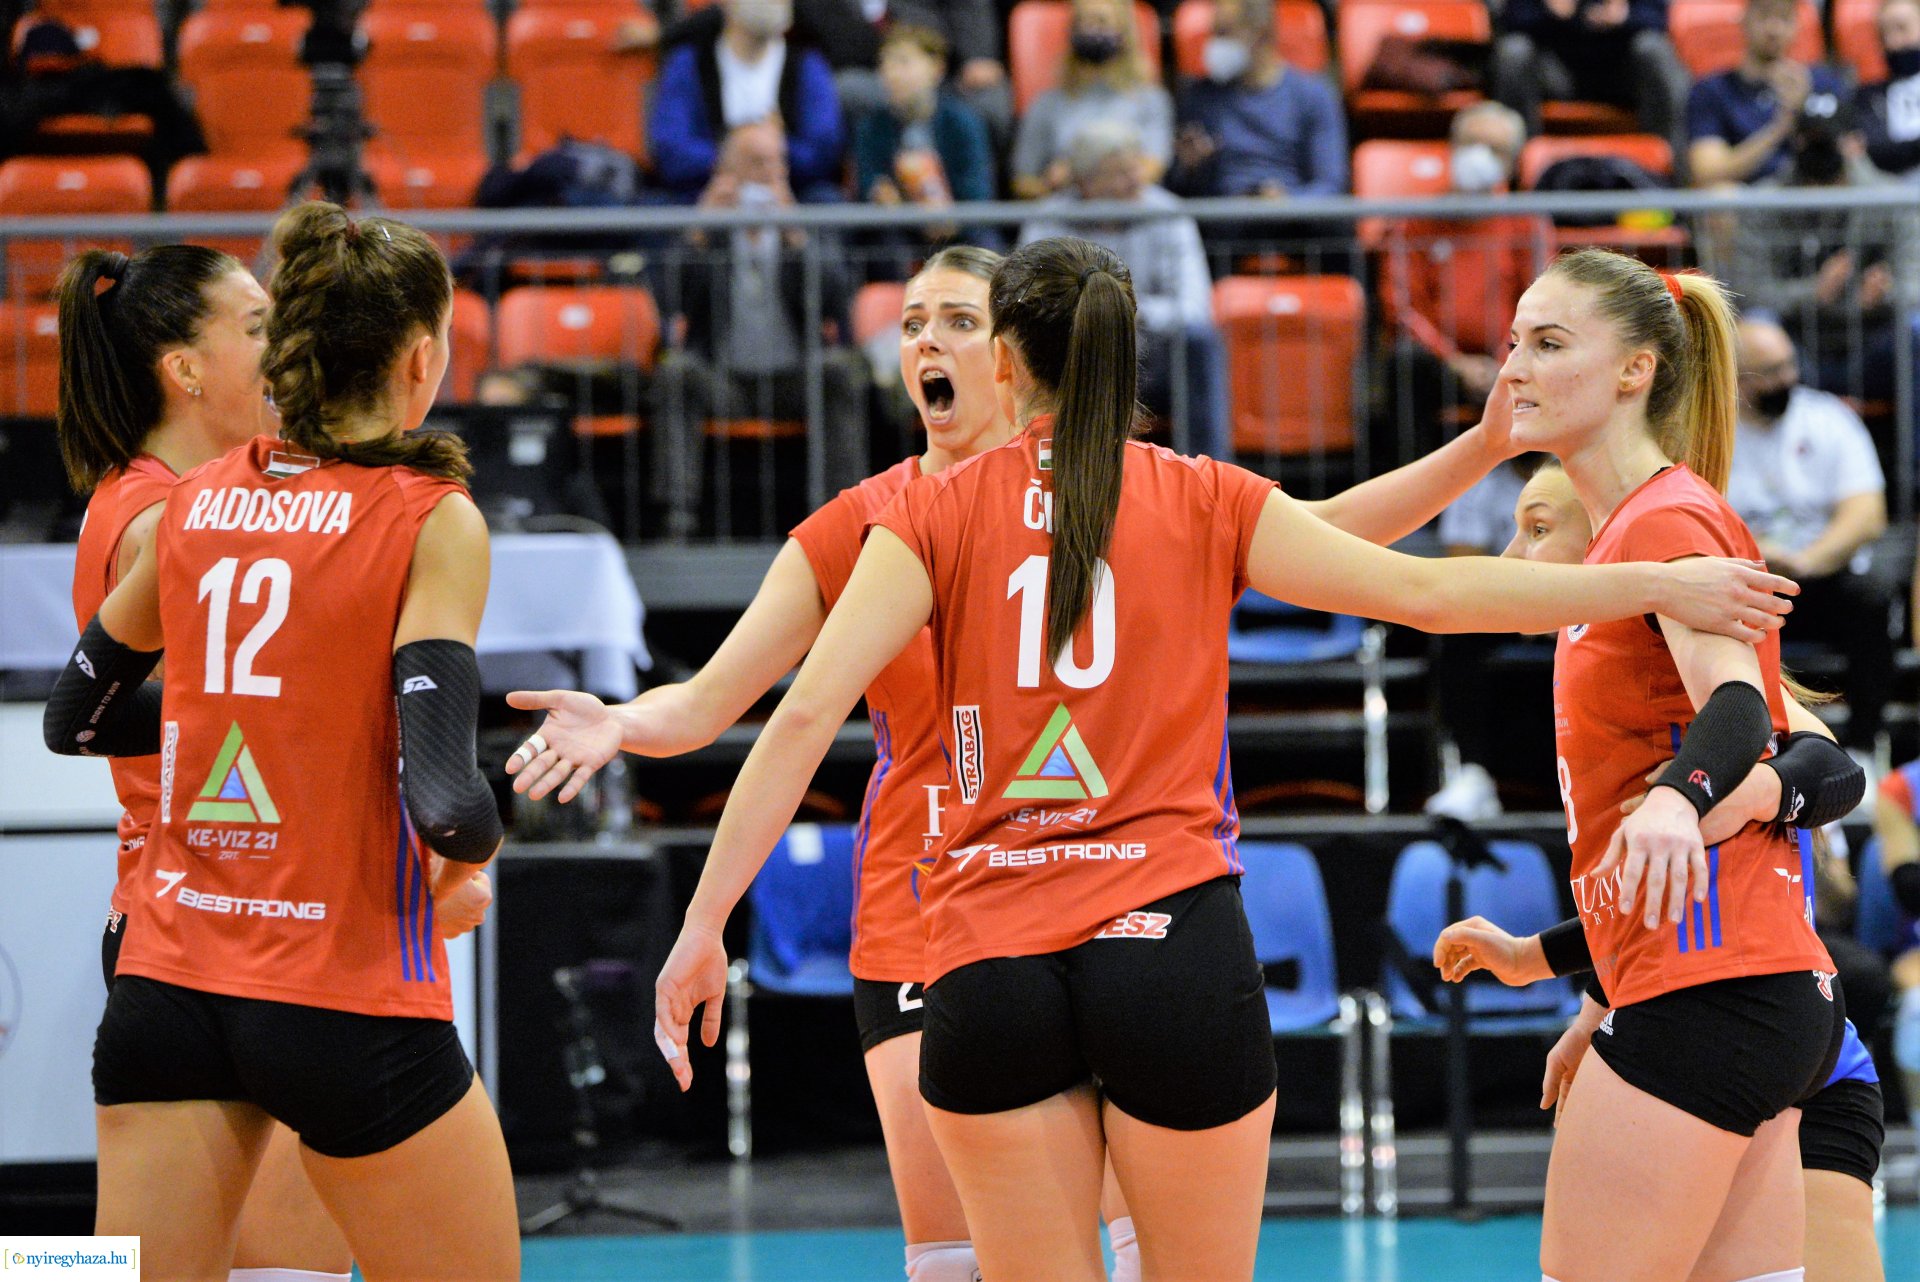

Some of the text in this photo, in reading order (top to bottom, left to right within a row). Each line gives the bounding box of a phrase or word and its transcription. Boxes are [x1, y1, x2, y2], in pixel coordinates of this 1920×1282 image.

[184, 487, 353, 534] RADOSOVA
[197, 557, 292, 698] 12
[1007, 554, 1115, 689] 10
[89, 681, 121, 724] BORN TO WIN
[961, 710, 978, 799] STRABAG
[1069, 807, 1098, 825] 21
[187, 828, 278, 850] KE-VIZ 21
[988, 843, 1146, 867] BESTRONG
[176, 887, 326, 920] BESTRONG
[1094, 911, 1172, 939] ESZ
